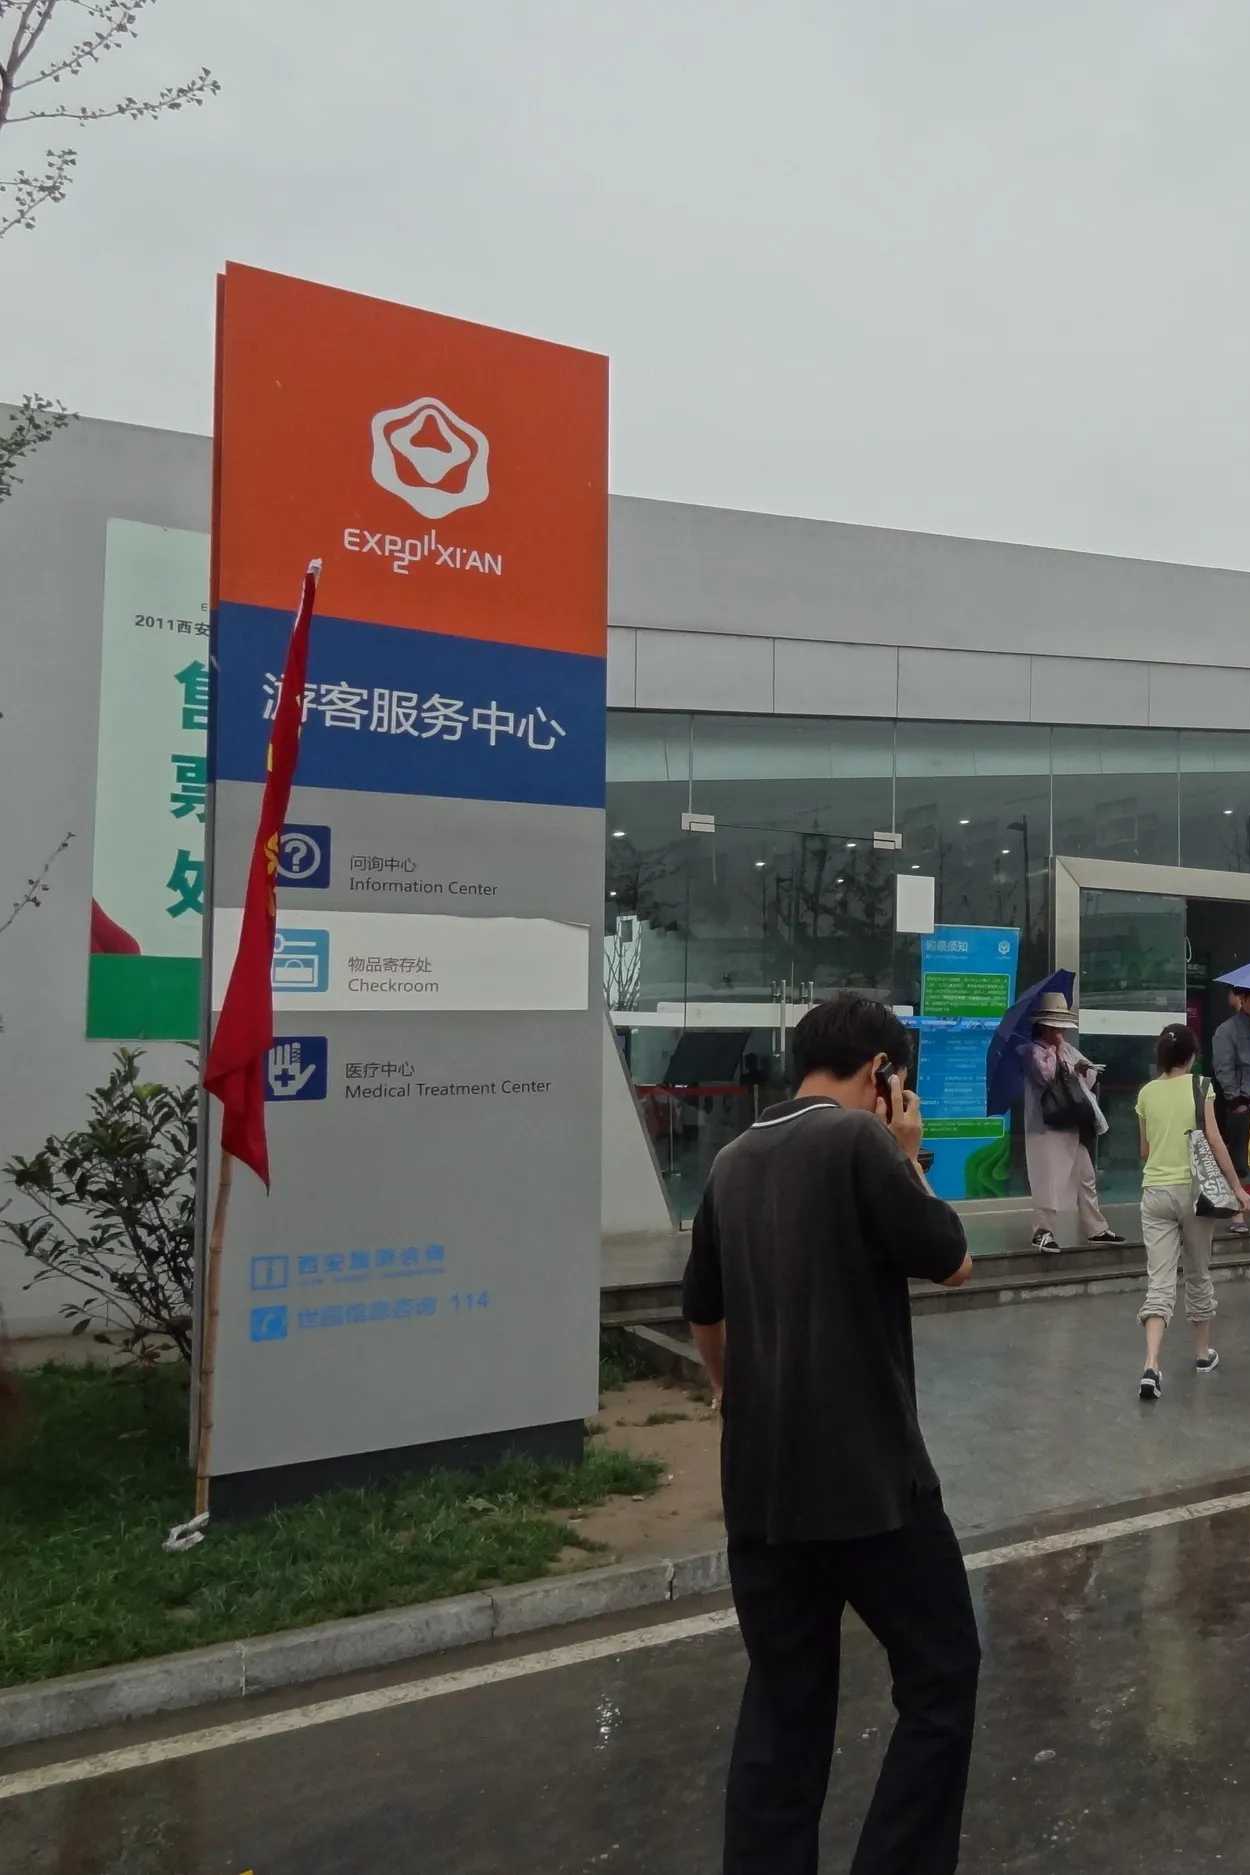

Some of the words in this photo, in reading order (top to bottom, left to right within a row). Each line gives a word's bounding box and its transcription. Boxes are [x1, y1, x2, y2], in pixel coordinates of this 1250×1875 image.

[350, 855, 417, 873] 问询中心
[349, 877, 444, 894] Information
[448, 881, 498, 896] Center
[347, 956, 433, 973] 物品寄存处
[347, 979, 440, 993] Checkroom
[345, 1061, 415, 1079] 医疗中心
[345, 1083, 411, 1099] Medical
[416, 1081, 496, 1096] Treatment
[501, 1080, 552, 1094] Center
[451, 1289, 490, 1312] 114
